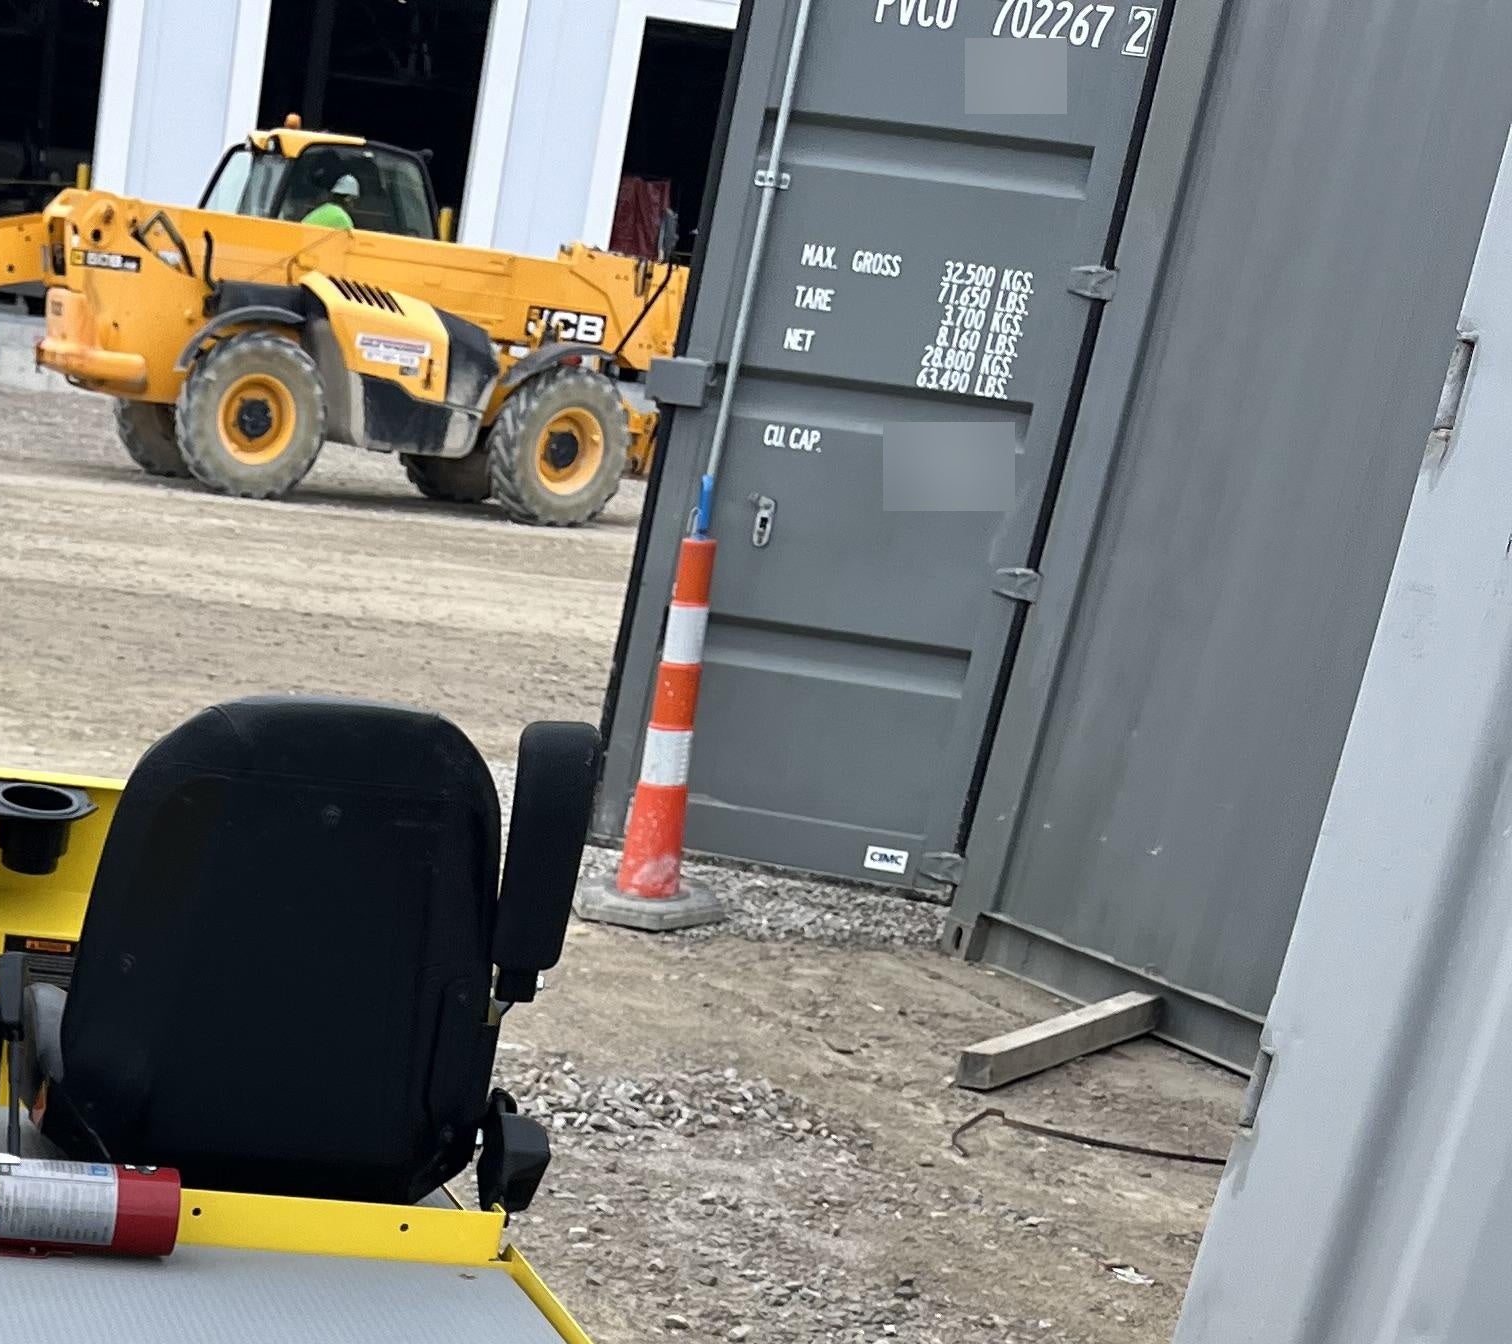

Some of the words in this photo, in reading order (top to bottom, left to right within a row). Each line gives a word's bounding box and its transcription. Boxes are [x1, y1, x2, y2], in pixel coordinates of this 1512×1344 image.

[991, 0, 1115, 48] 702267
[1124, 10, 1152, 53] 2
[801, 244, 838, 270] MAX.
[851, 250, 903, 277] GROSS
[1000, 268, 1034, 294] KGS.
[794, 285, 835, 312] TARE
[989, 311, 1023, 337] KGS.
[937, 281, 991, 310] 71.650
[995, 290, 1029, 316] LBS.
[783, 327, 815, 352] NET
[979, 353, 1013, 379] KGS.
[984, 332, 1019, 358] LBS.
[974, 373, 1008, 400] LBS.
[789, 428, 822, 453] CAP.
